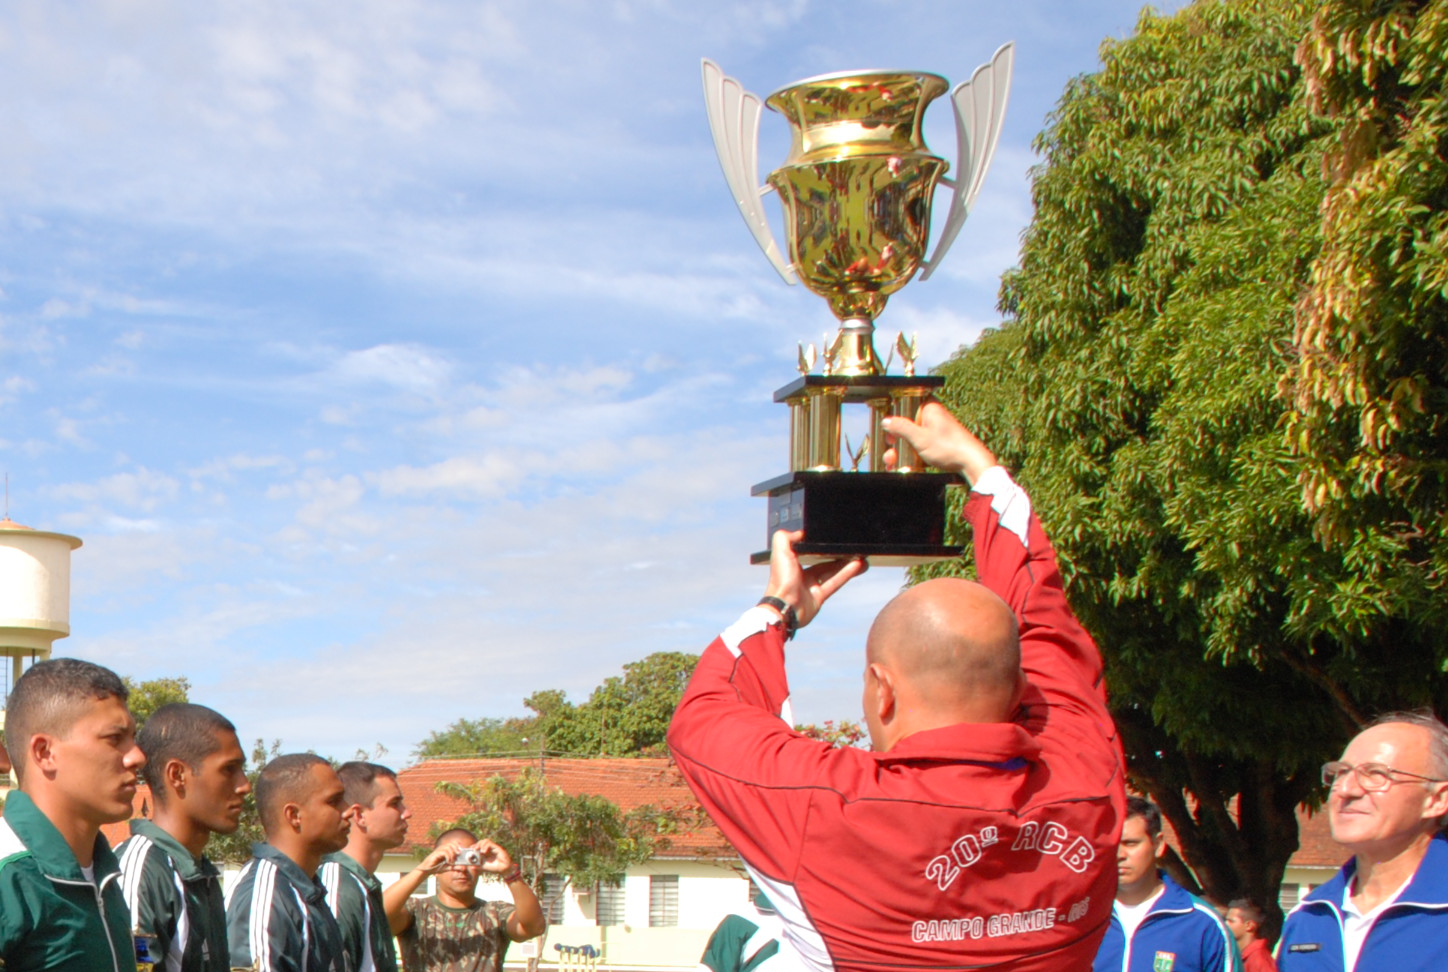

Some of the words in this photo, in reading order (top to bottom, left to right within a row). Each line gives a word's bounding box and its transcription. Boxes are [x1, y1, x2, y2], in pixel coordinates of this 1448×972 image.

[1011, 821, 1095, 873] RCB
[912, 916, 984, 942] CAMPO
[987, 907, 1057, 938] GRANDE
